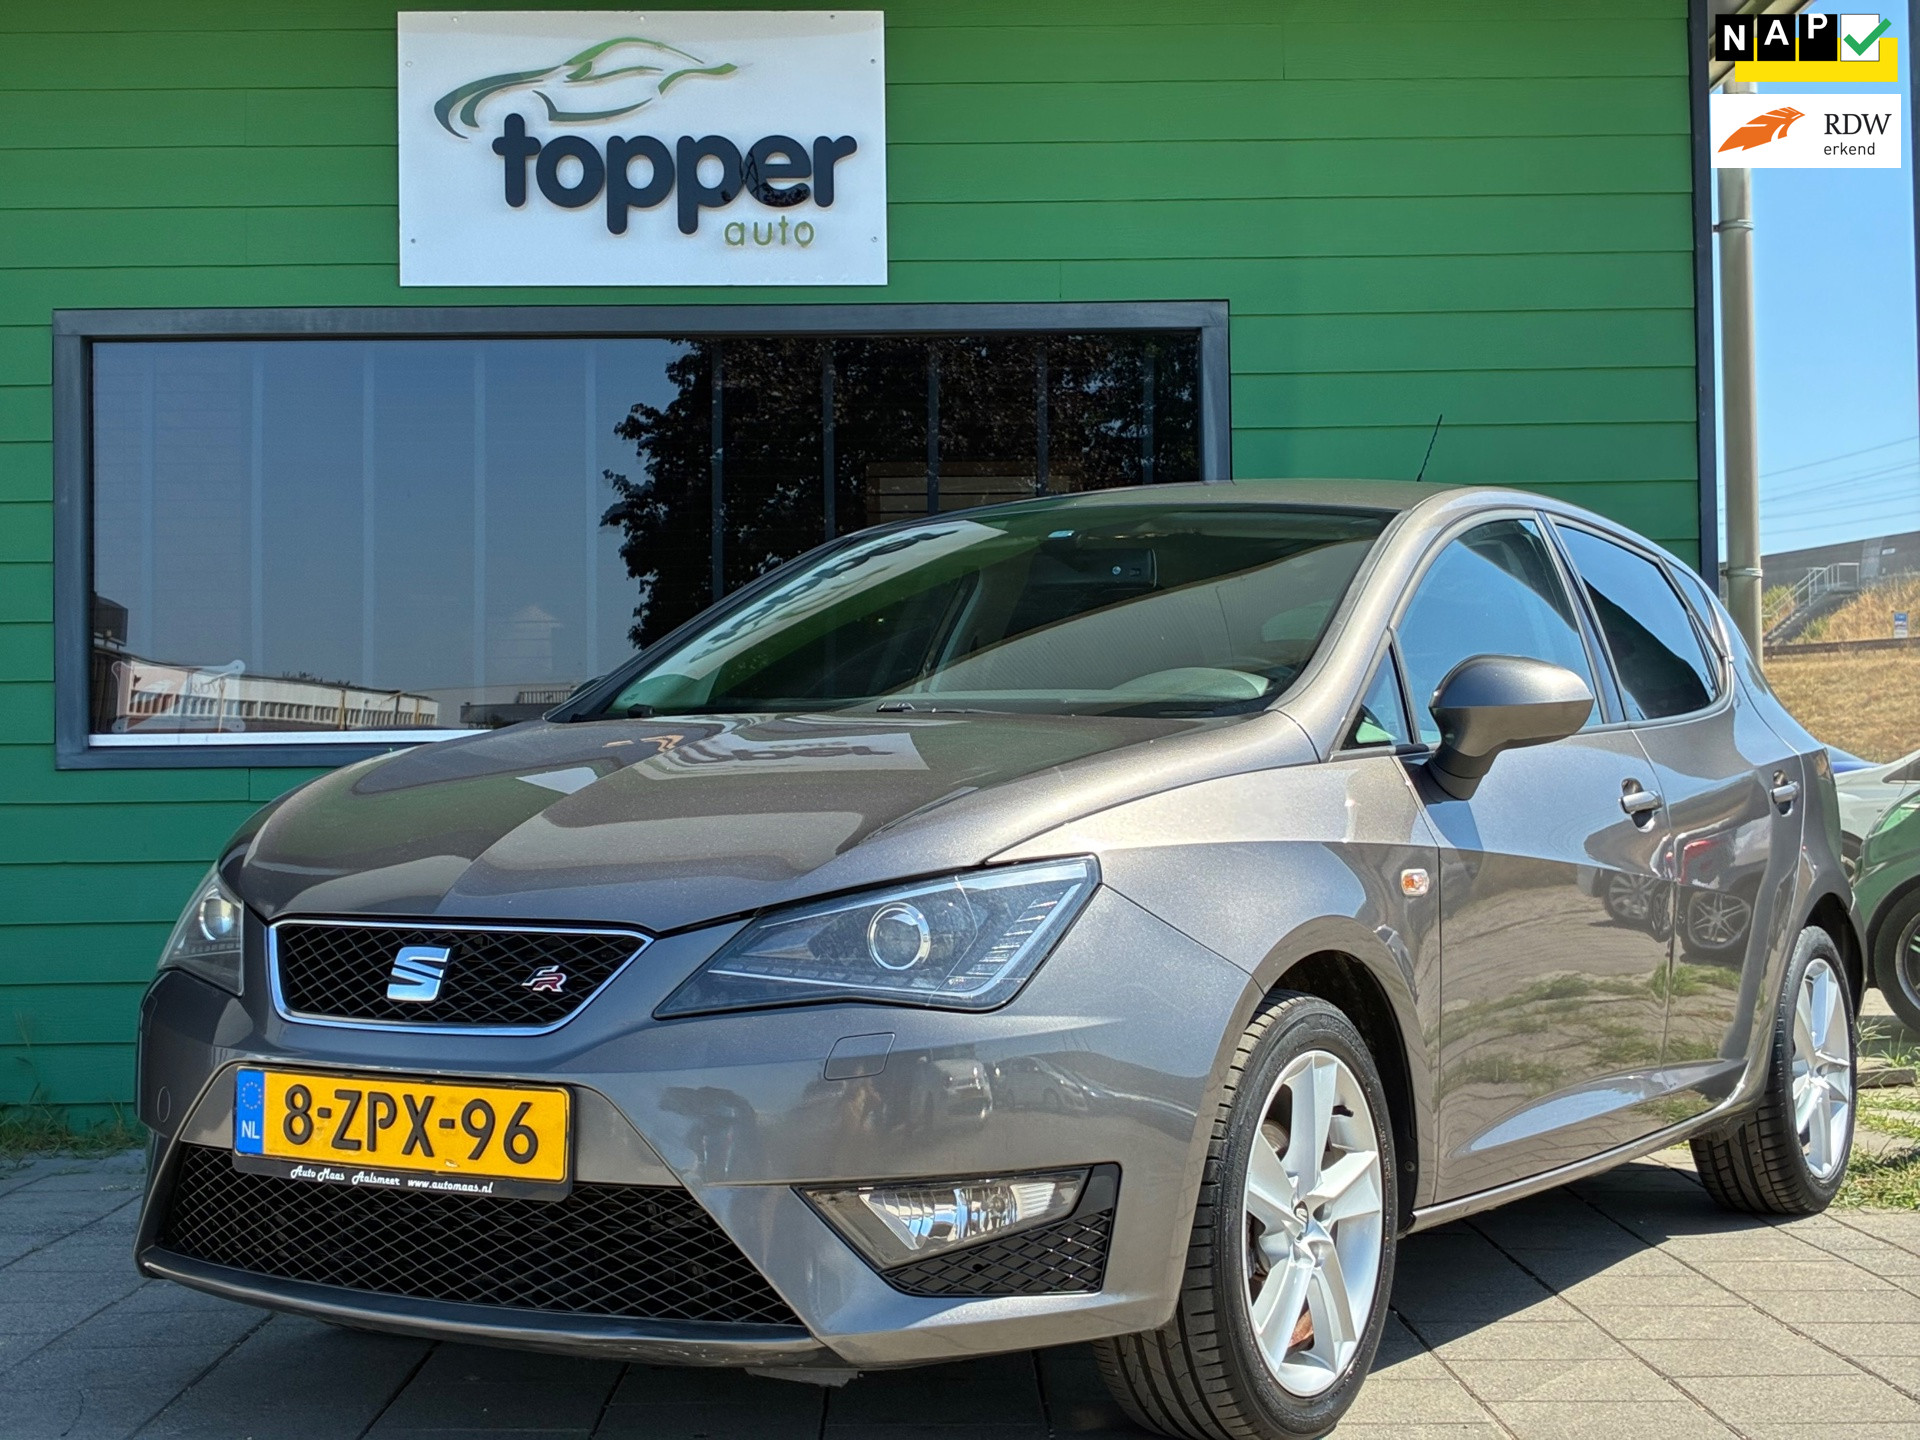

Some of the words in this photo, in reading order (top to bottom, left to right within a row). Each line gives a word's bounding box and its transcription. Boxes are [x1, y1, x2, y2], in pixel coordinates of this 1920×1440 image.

[492, 113, 858, 235] topper
[724, 216, 815, 246] auto
[241, 1120, 260, 1140] NL
[283, 1084, 539, 1165] 8-ZPX-96
[290, 1166, 316, 1179] Auto
[317, 1168, 345, 1181] Maas
[351, 1171, 400, 1186] Aalsmeer
[407, 1178, 494, 1194] www.automaas.nl
